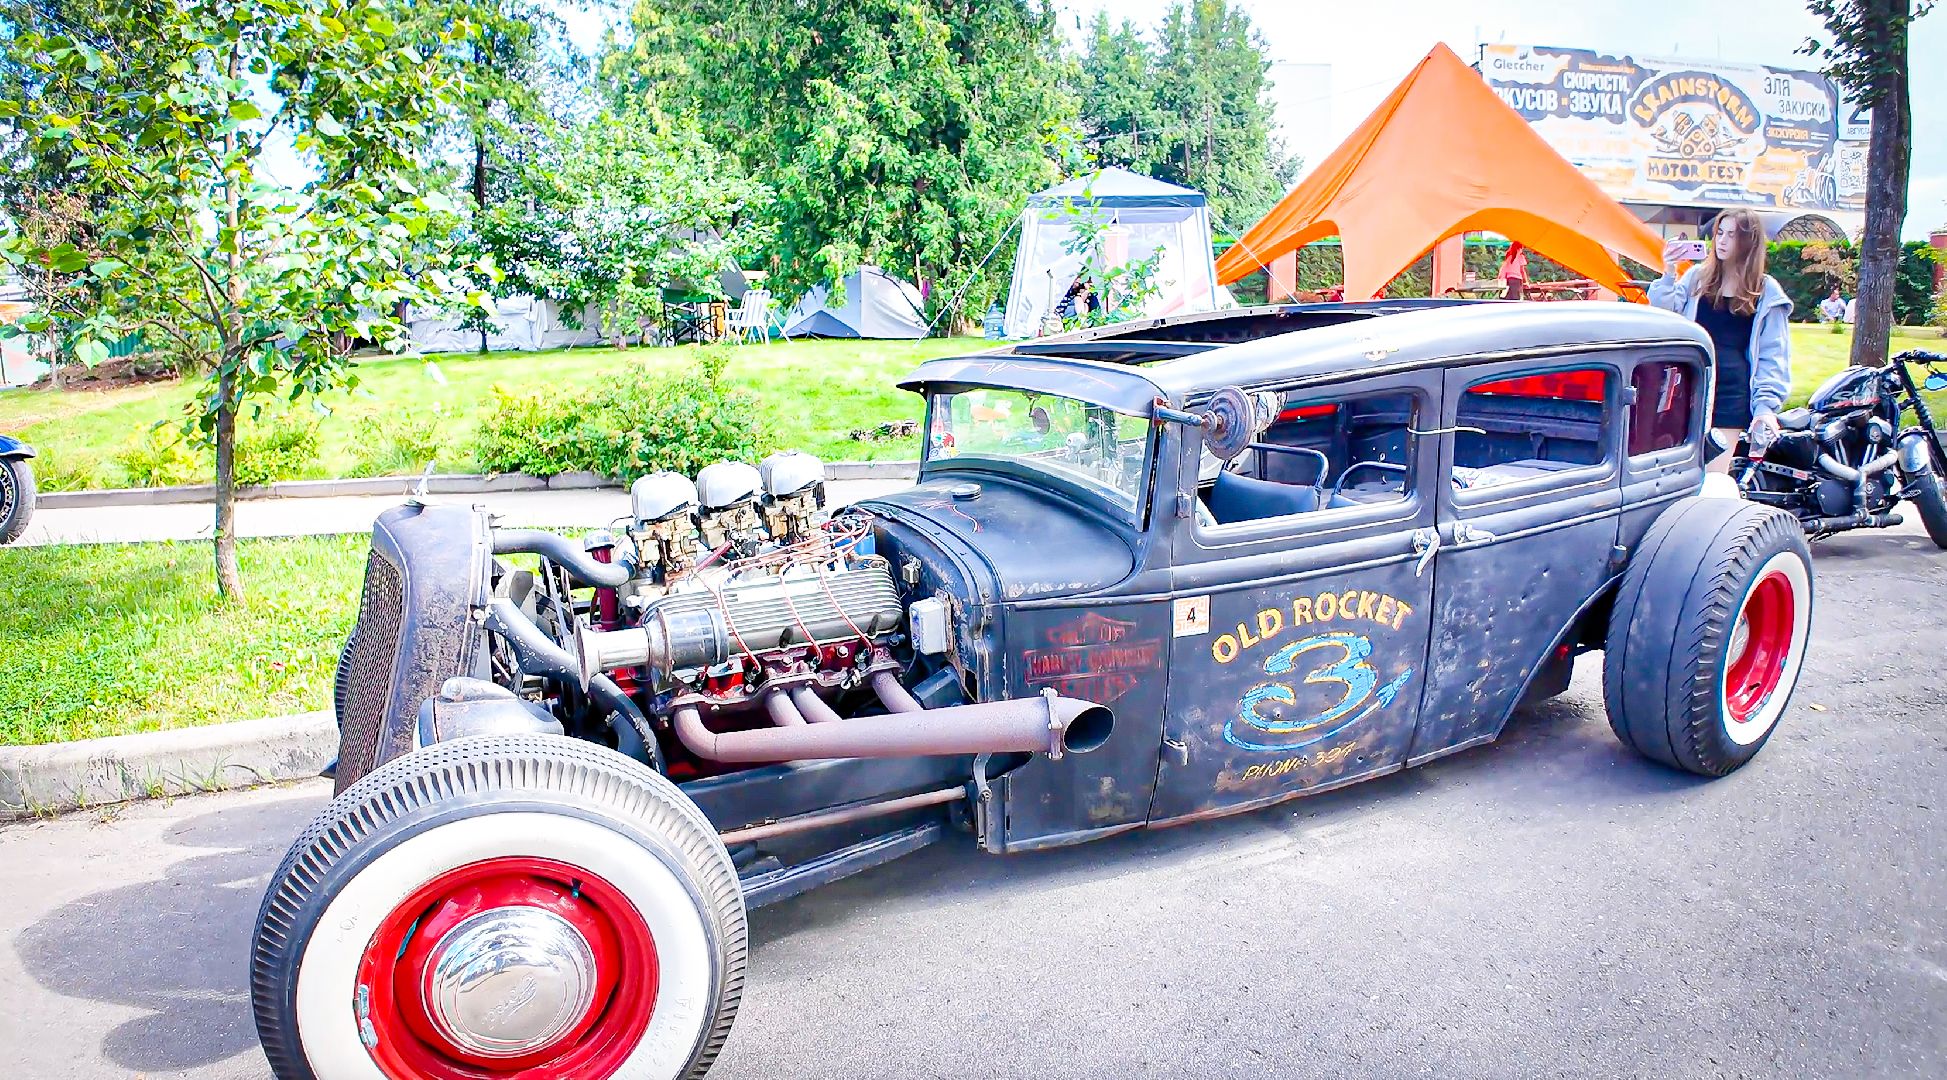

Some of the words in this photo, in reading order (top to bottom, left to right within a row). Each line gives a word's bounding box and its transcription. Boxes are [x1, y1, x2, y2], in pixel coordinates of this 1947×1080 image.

[1493, 58, 1545, 71] Gletcher
[1563, 71, 1631, 95] СКОРОСТИ,
[1764, 76, 1791, 97] ЭЛЯ
[1569, 91, 1623, 115] ЗВУКА
[1634, 78, 1754, 128] BRAINSTORM
[1778, 99, 1825, 117] ЗАКУСКИ
[1648, 162, 1699, 178] MOTOR
[1708, 165, 1744, 180] FEST
[1186, 606, 1197, 624] 4
[1212, 608, 1285, 664] OLD
[1293, 590, 1414, 631] ROCKET
[1239, 631, 1380, 734] 3
